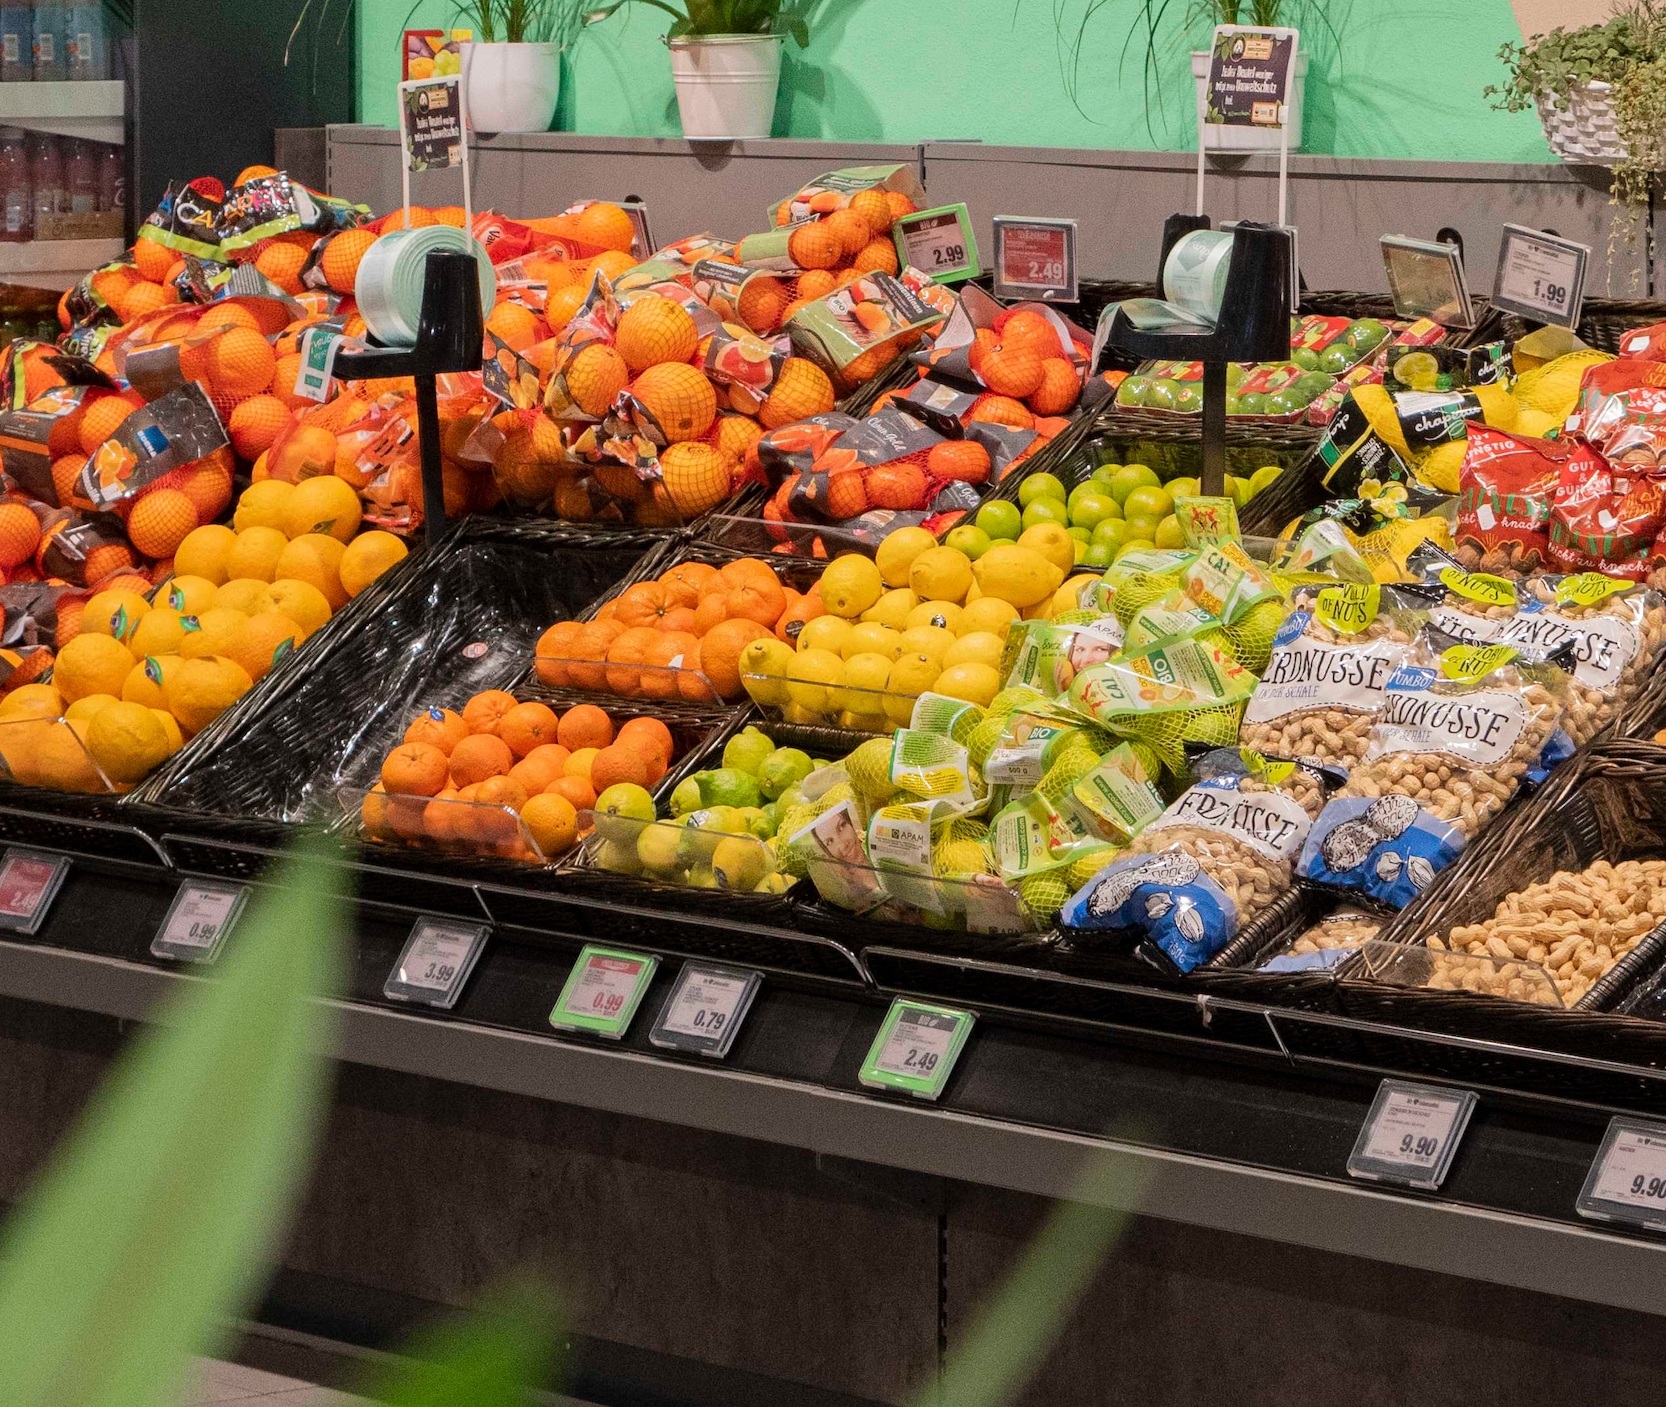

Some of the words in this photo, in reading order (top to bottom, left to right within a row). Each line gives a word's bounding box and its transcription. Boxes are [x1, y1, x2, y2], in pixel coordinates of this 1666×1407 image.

[933, 245, 965, 266] 2.99
[1029, 261, 1063, 280] 2.49
[1533, 279, 1567, 303] 1.99
[1568, 460, 1595, 473] GUT
[1333, 602, 1368, 624] NUTS
[1029, 727, 1050, 739] BIO
[901, 830, 924, 842] APAM
[189, 922, 217, 940] 0.99
[424, 962, 454, 982] 3.99
[592, 991, 624, 1012] 0.99
[694, 1008, 725, 1030] 0.79
[904, 1048, 938, 1071] 2.49
[1399, 1133, 1438, 1157] 9.90
